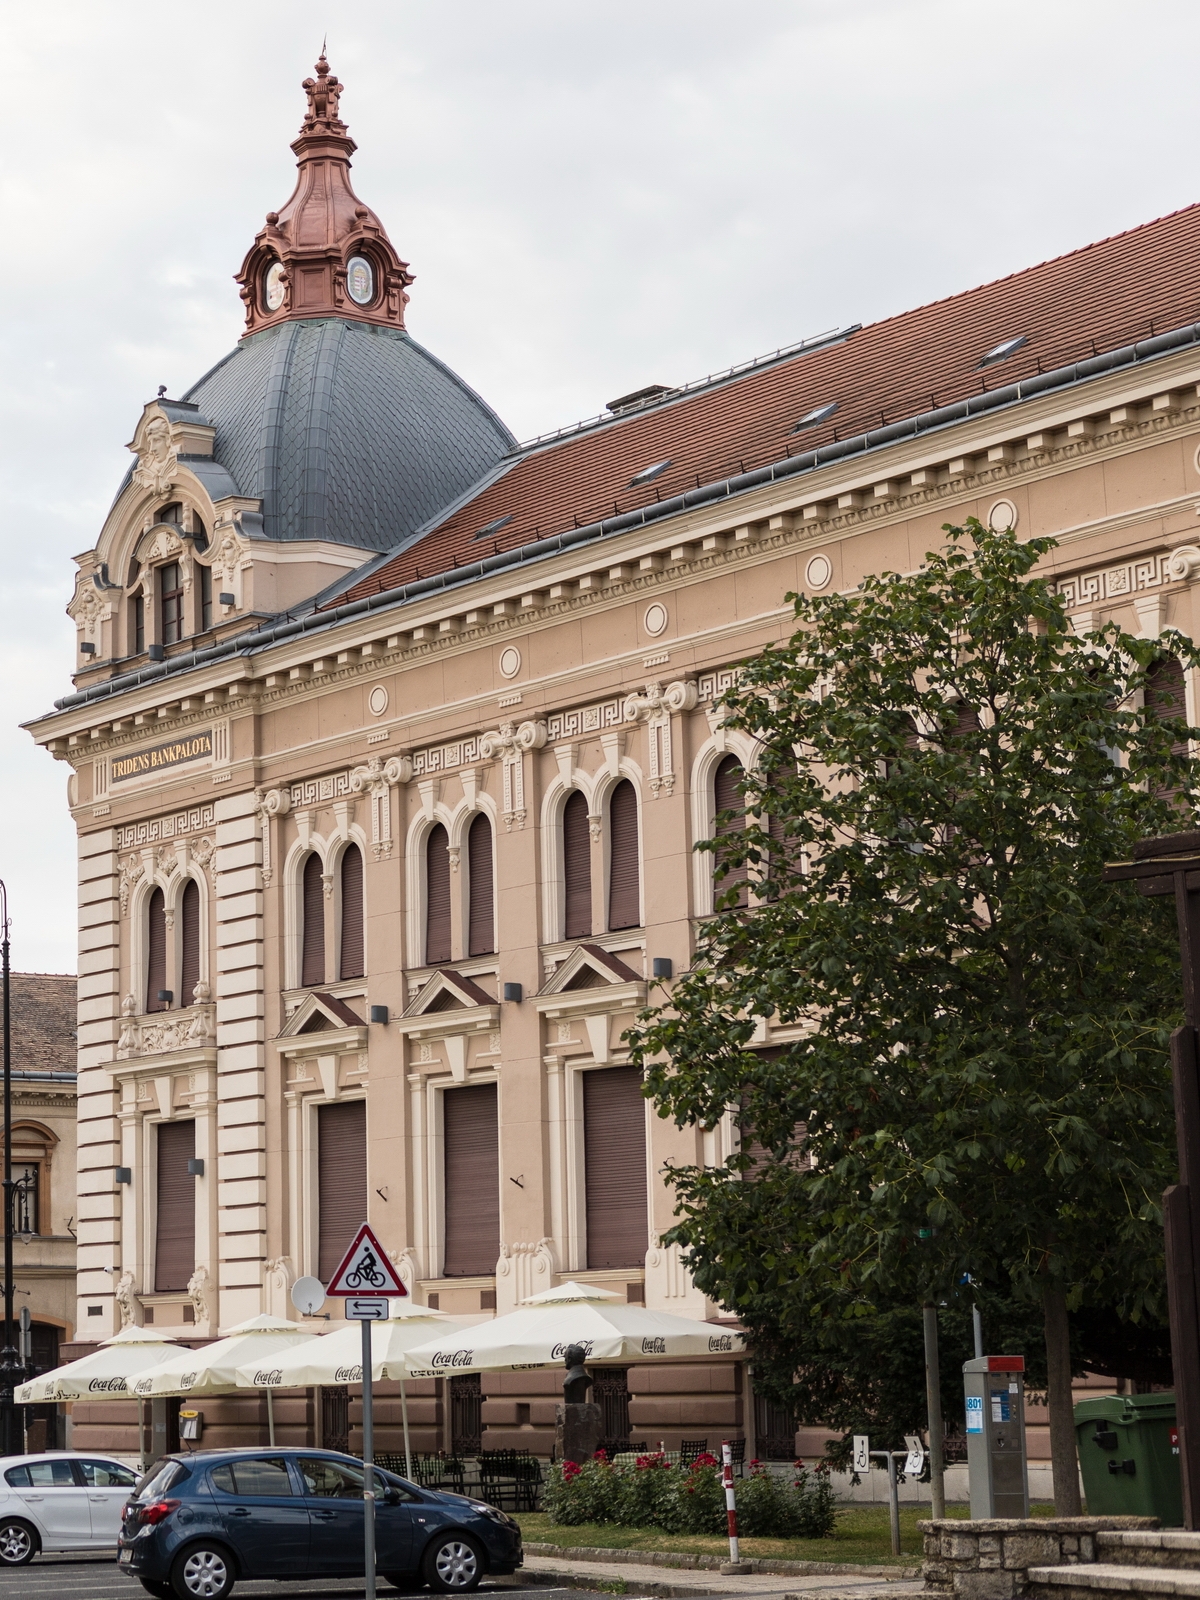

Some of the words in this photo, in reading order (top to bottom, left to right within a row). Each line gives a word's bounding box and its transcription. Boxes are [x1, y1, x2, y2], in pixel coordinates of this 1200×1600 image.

[112, 753, 149, 779] TRIDENS
[151, 736, 211, 767] BANKPALOTA
[432, 1349, 474, 1368] Coca-Cola
[89, 1377, 127, 1392] Coca-Cola
[253, 1369, 283, 1386] Coca-Cola
[968, 1398, 982, 1409] 801
